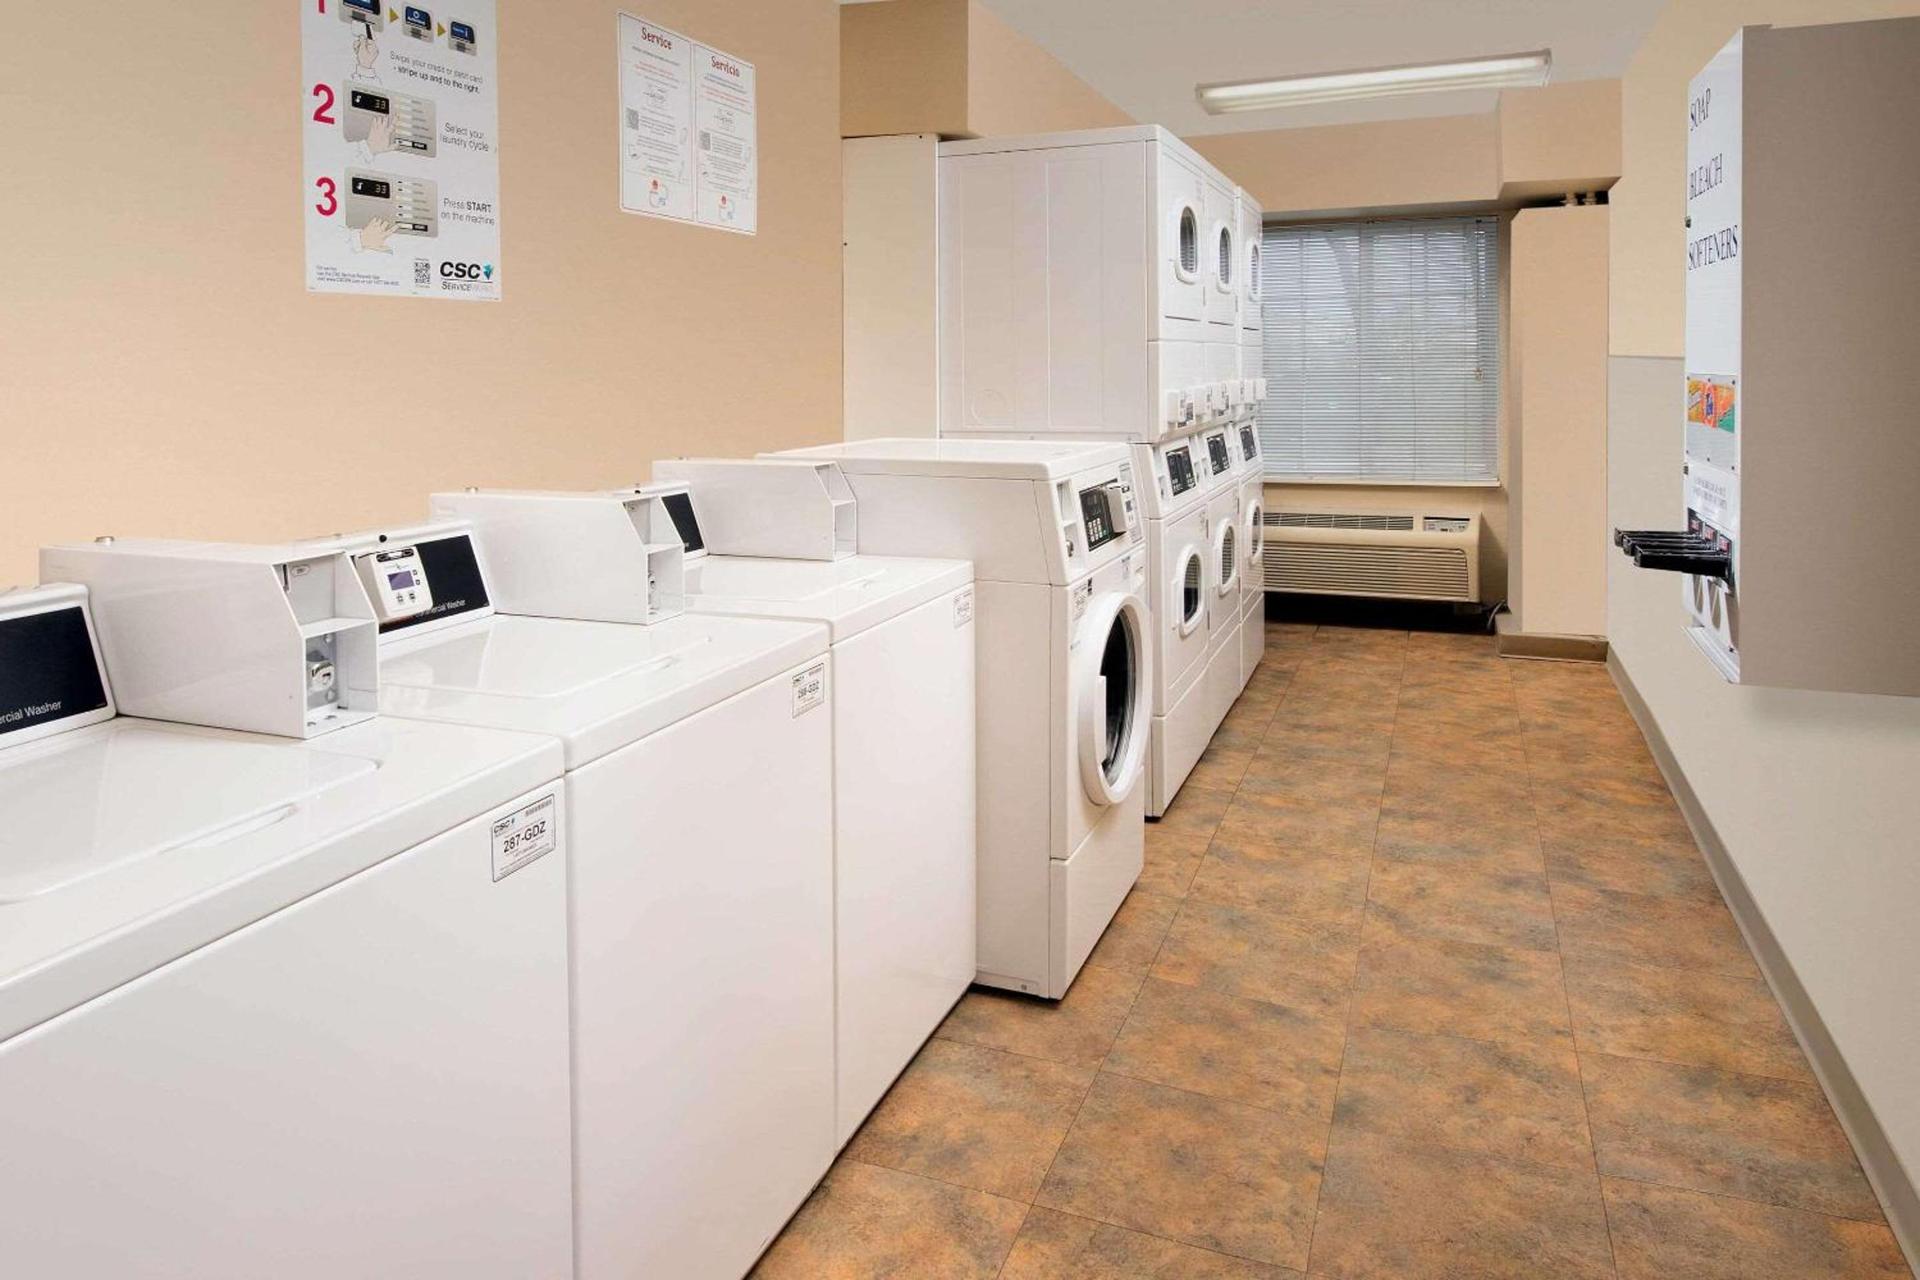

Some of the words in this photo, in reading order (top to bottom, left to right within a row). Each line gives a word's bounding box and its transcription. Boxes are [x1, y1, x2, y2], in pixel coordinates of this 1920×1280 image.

[641, 27, 672, 50] Service
[412, 59, 426, 68] your
[419, 71, 429, 82] up
[430, 74, 442, 84] and
[443, 77, 451, 86] to
[452, 79, 463, 89] the
[313, 83, 335, 125] 2
[1690, 87, 1711, 132] SOAP
[444, 122, 468, 136] Select
[469, 129, 485, 140] your
[442, 135, 468, 149] laundry
[468, 139, 489, 152] cycle
[1689, 152, 1723, 200] BLEACH
[315, 176, 338, 217] 3
[443, 197, 465, 210] Press
[466, 201, 492, 213] START
[440, 211, 451, 220] on
[452, 211, 464, 222] the
[465, 214, 495, 226] machine
[1688, 224, 1738, 271] SOFTENERS
[440, 261, 480, 280] CSC
[24, 700, 62, 717] Washer
[503, 820, 547, 854] 287-GDZ
